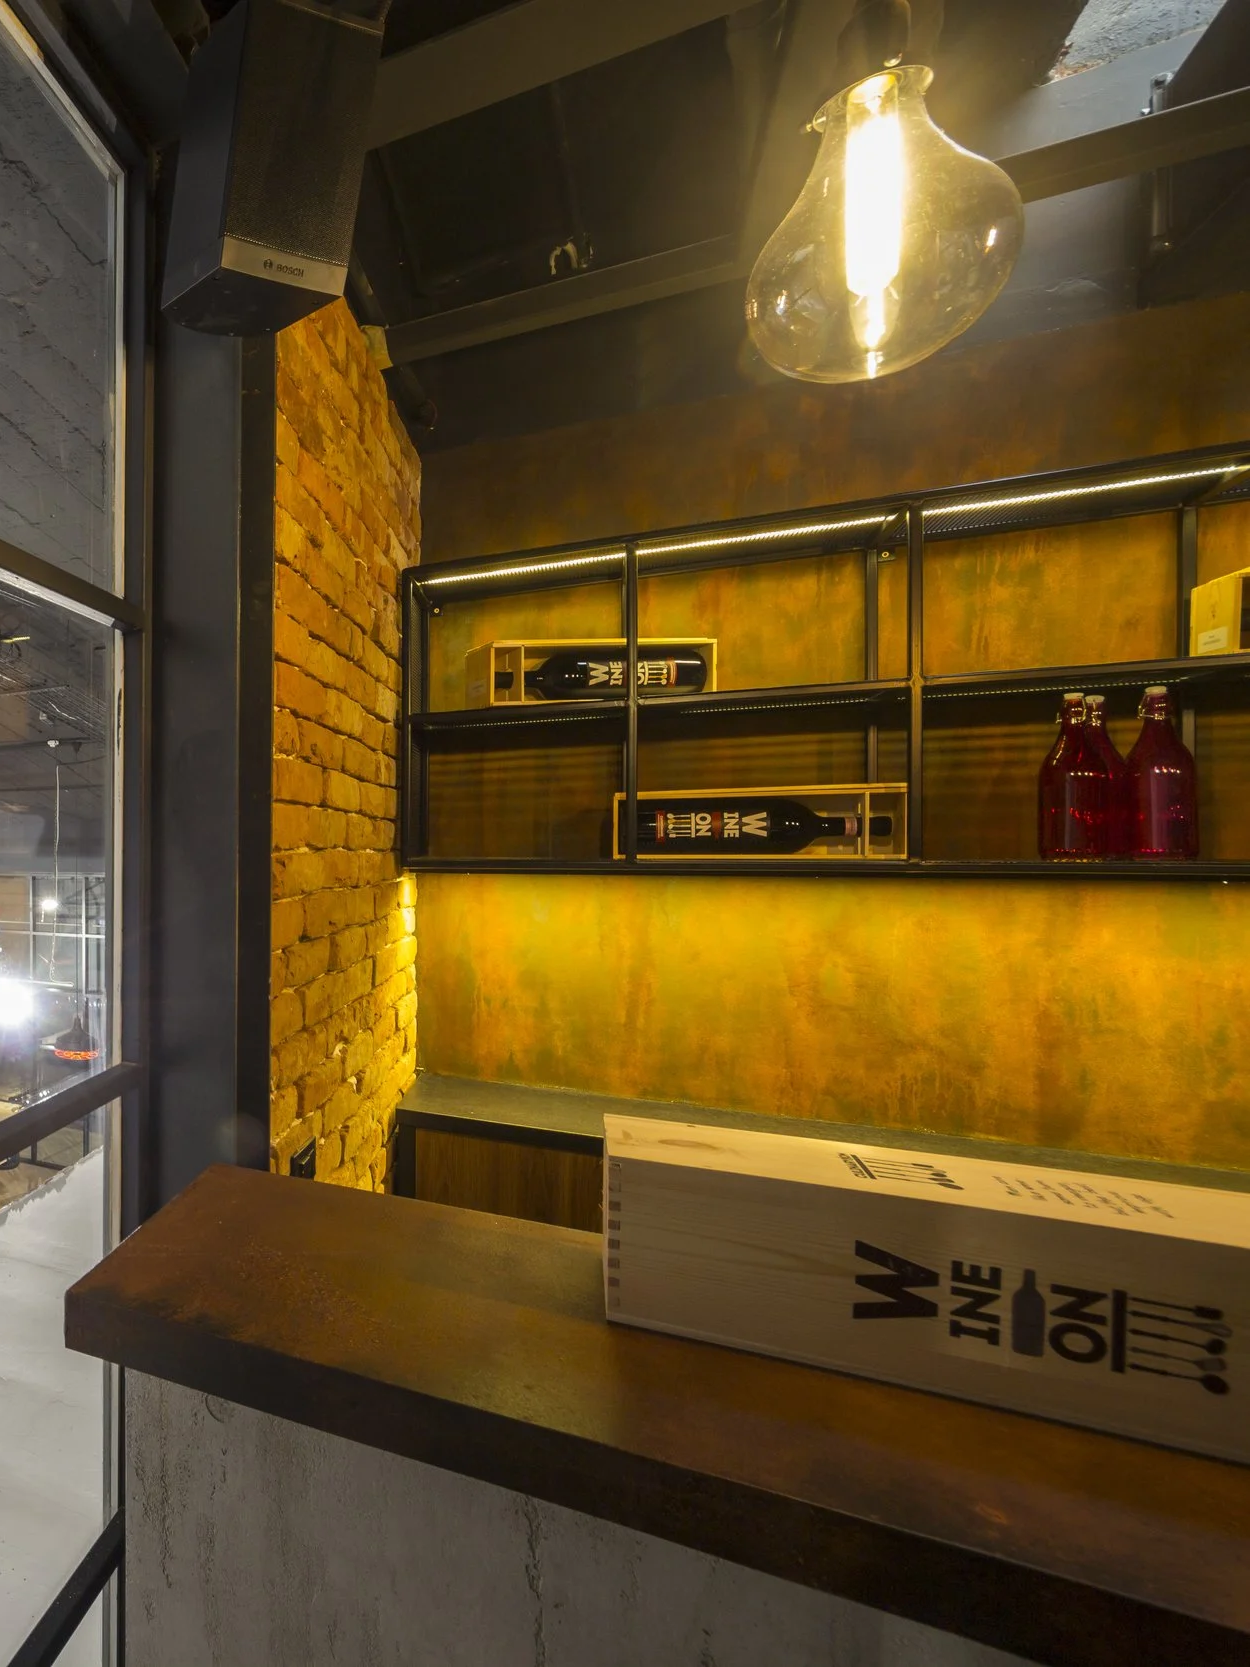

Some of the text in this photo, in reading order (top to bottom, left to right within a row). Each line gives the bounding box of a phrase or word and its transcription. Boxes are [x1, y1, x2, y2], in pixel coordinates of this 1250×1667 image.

[276, 264, 304, 277] BOSCH
[588, 662, 609, 686] W
[695, 812, 712, 837] ON
[723, 812, 740, 838] INE
[741, 811, 768, 838] W
[853, 1239, 940, 1320] W
[949, 1259, 1002, 1347] INE
[1049, 1282, 1108, 1364] ON
